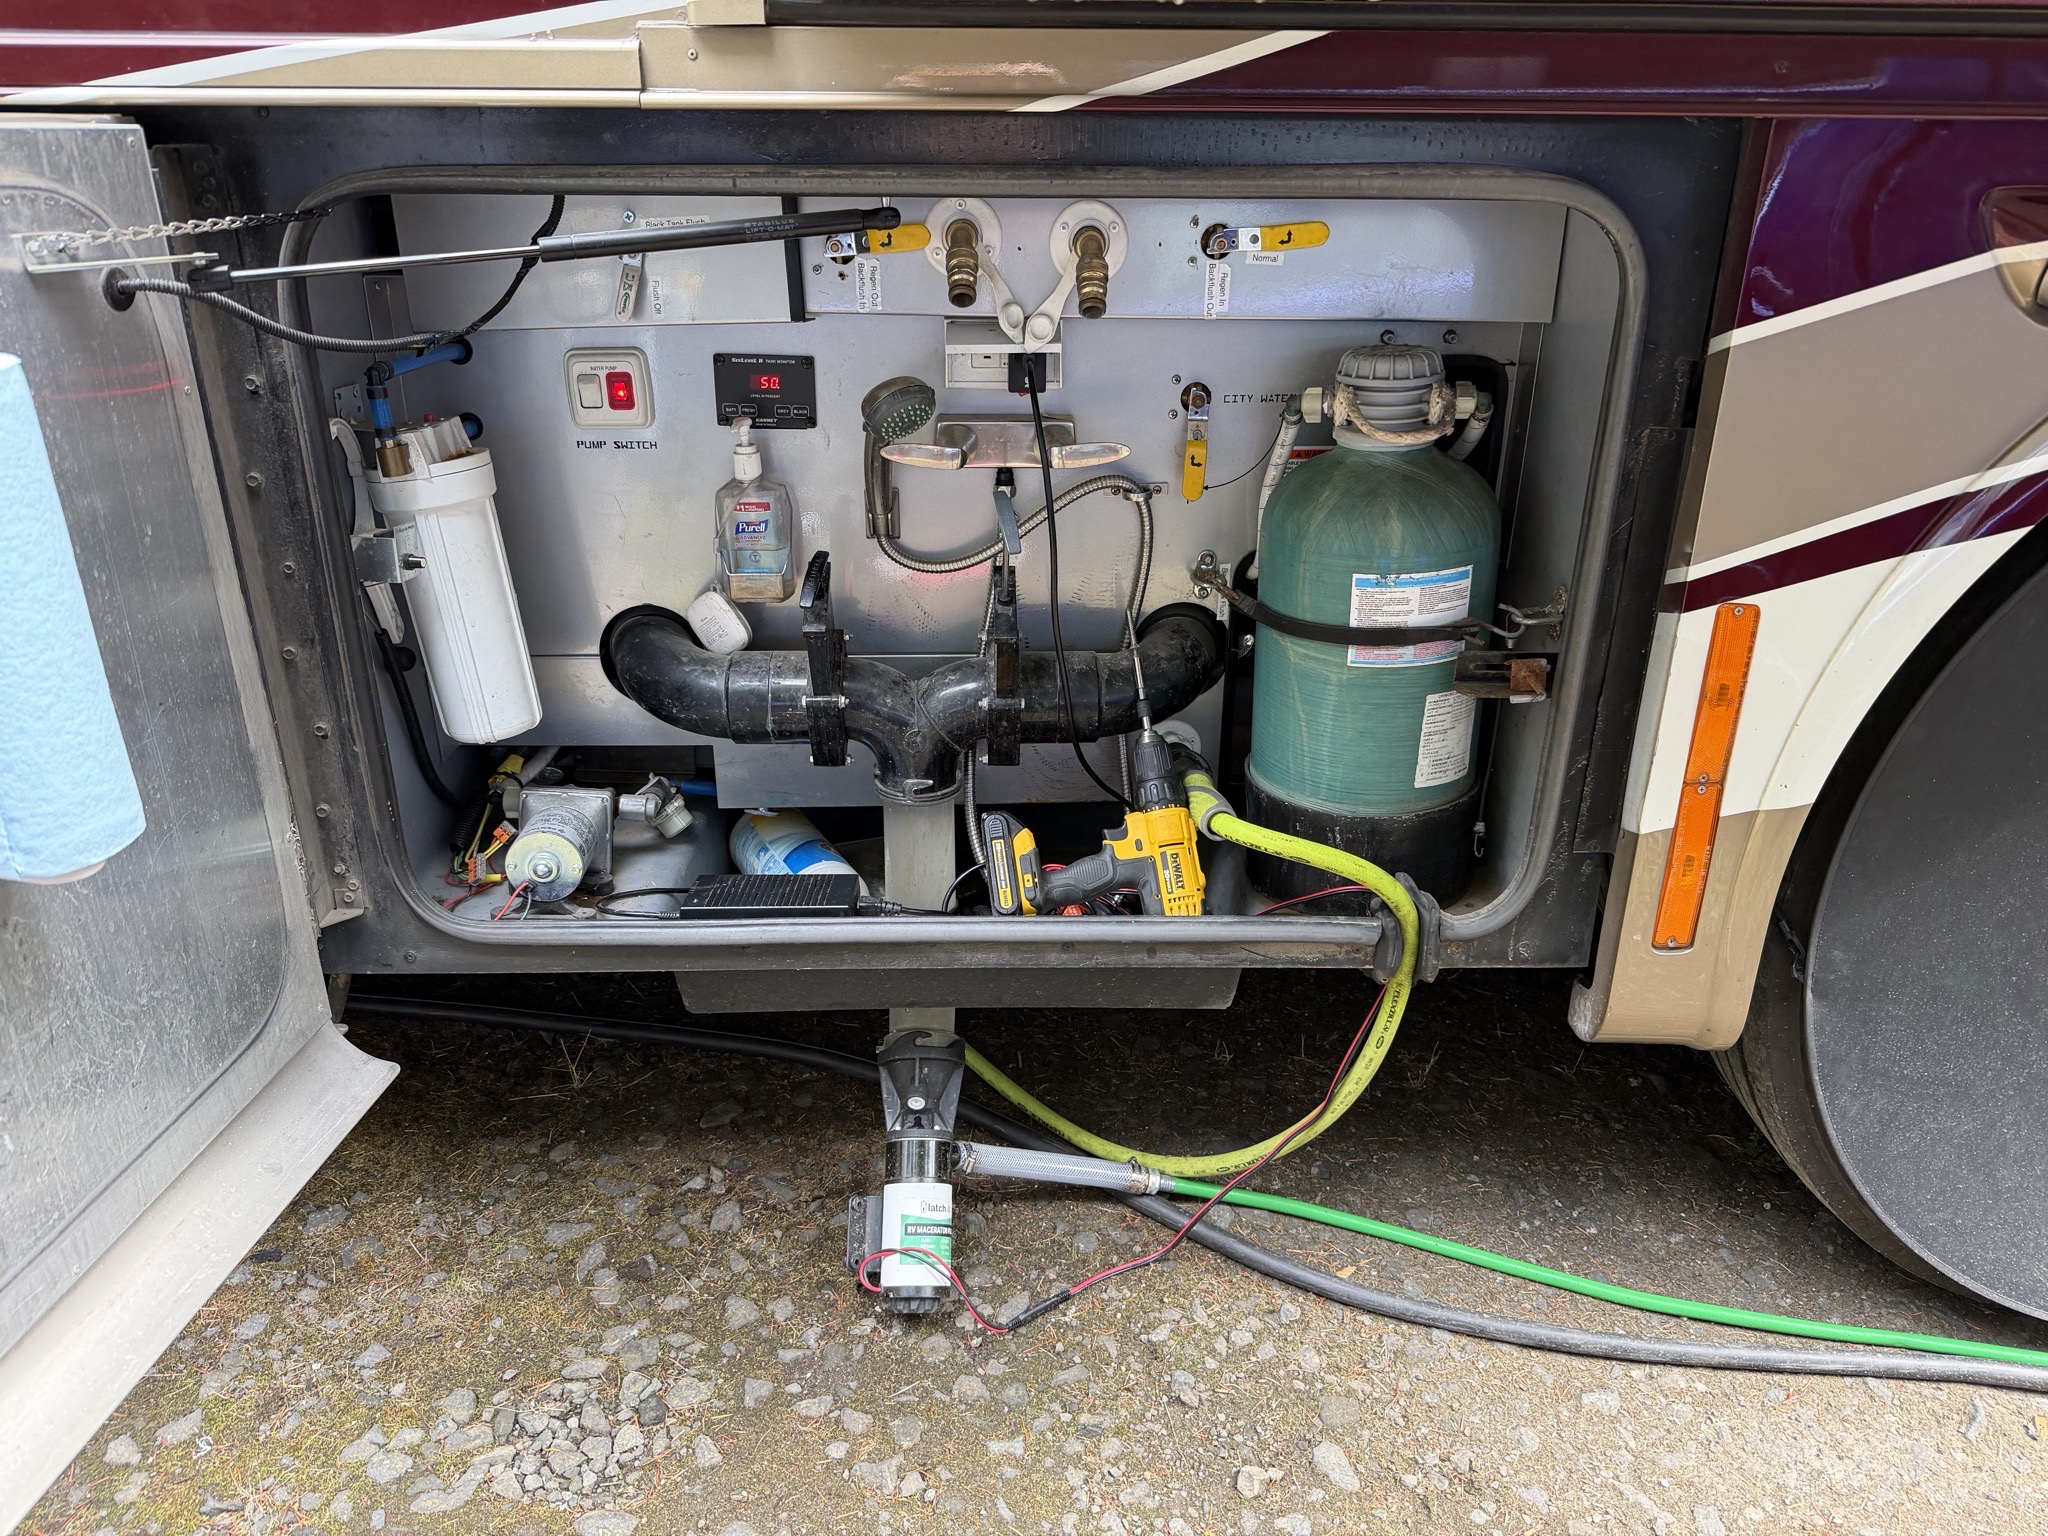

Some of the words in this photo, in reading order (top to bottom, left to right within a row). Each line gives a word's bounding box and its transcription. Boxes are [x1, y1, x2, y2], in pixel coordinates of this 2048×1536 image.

[744, 218, 795, 228] STABILUS
[745, 224, 795, 234] LIFT-O-MAT
[1252, 254, 1279, 263] Normal
[857, 263, 866, 300] Backflush
[869, 266, 878, 291] Regen
[1207, 263, 1216, 301] Backflush
[1219, 272, 1228, 297] Regen
[652, 280, 660, 301] Flush
[871, 292, 879, 307] Out
[1219, 299, 1226, 307] In
[654, 303, 662, 315] Off
[859, 302, 867, 310] In
[1206, 302, 1214, 317] Out
[1224, 394, 1253, 403] CITY
[1261, 394, 1296, 403] WATE
[576, 440, 607, 449] PUMP
[613, 441, 658, 449] SWITCH
[739, 522, 766, 532] Purell
[1219, 601, 1227, 617] Flush
[928, 1203, 947, 1212] latch
[907, 1226, 916, 1234] RV
[916, 1226, 948, 1234] MACERATOR
